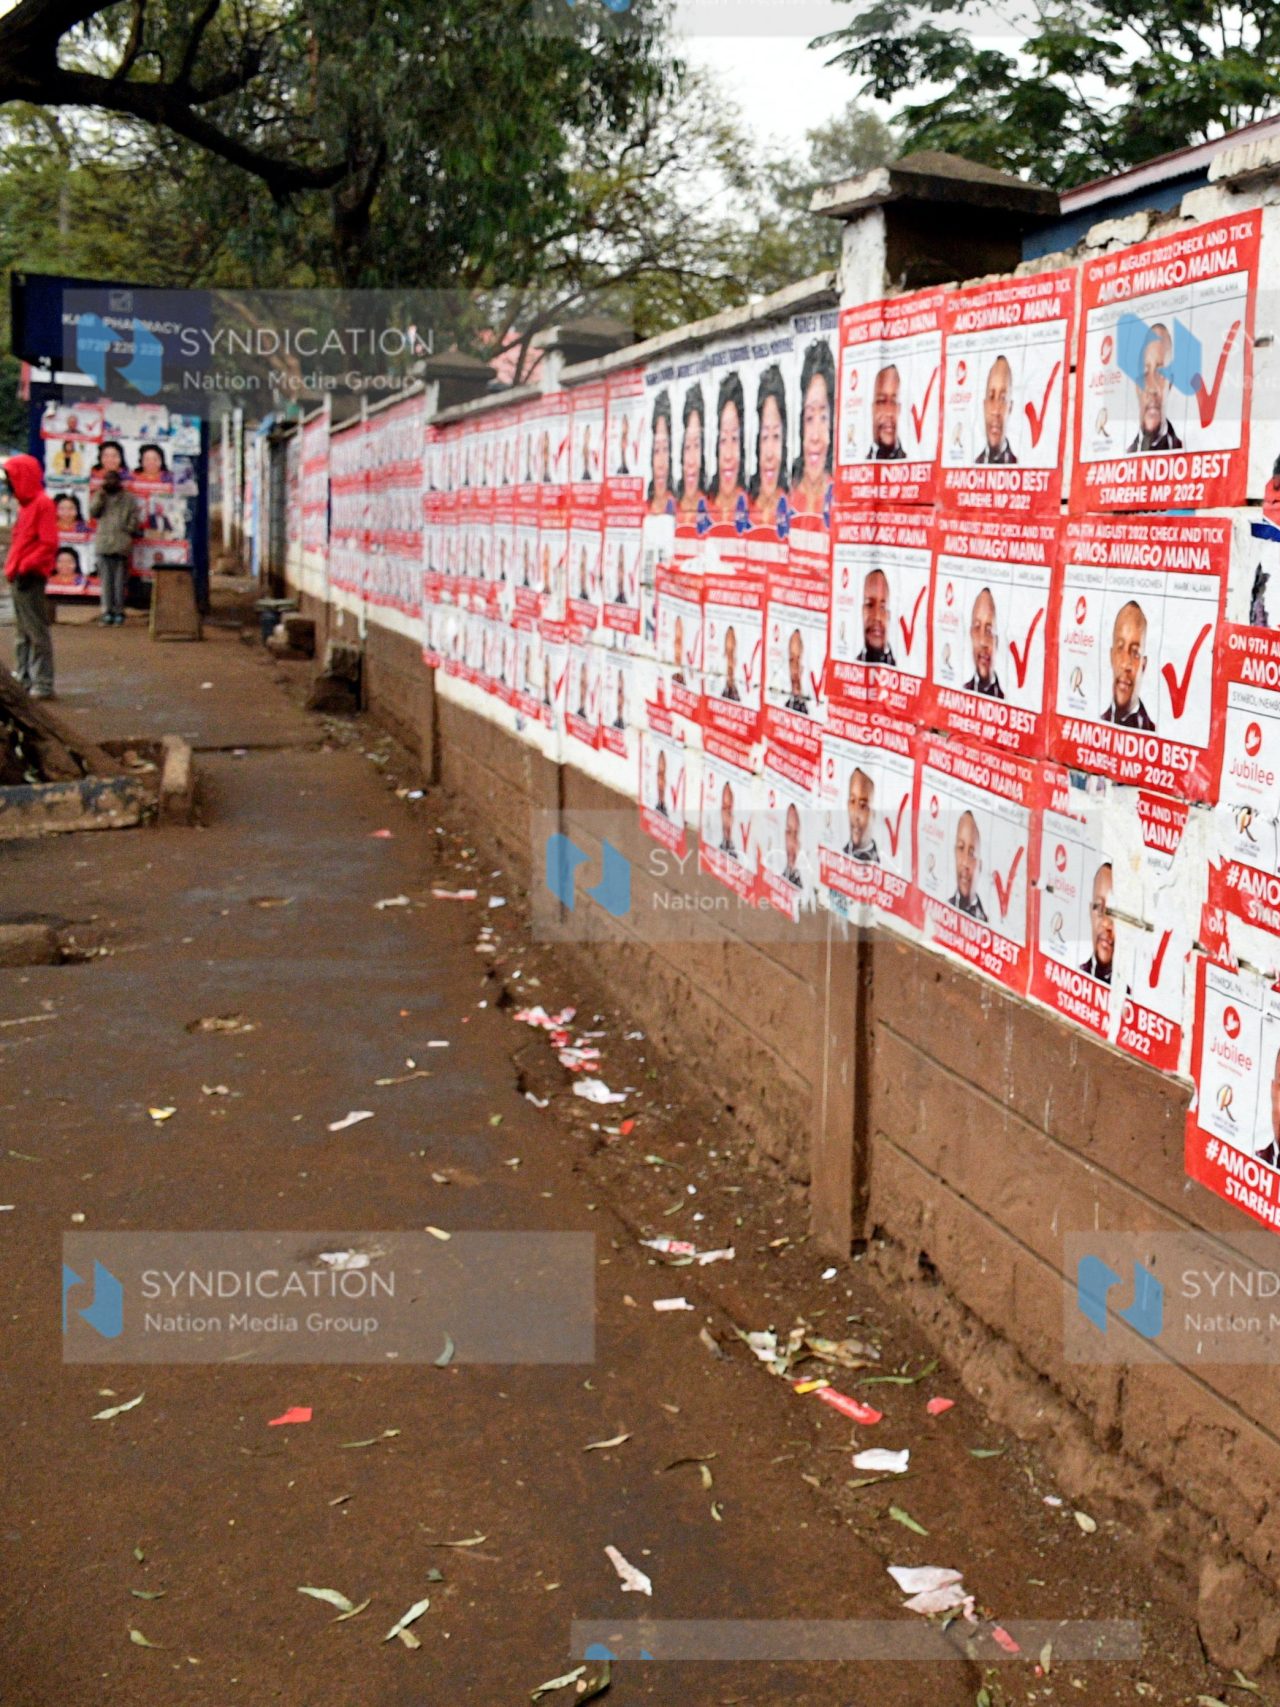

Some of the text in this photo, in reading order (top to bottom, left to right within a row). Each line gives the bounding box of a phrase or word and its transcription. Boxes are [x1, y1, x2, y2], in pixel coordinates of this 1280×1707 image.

[1230, 222, 1252, 240] TICK
[1133, 247, 1237, 293] MWAGO MAINA
[1022, 471, 1050, 492] BEST
[1086, 454, 1230, 486] #AMOH NDIO BEST
[1100, 483, 1204, 504] STAREHE MP 2022
[1180, 526, 1224, 544] AND TICK
[1010, 542, 1045, 562] MAINA
[1074, 542, 1211, 570] AMOS MWAGO MAINA
[1228, 634, 1247, 650] ON
[1248, 636, 1269, 657] 9TH
[978, 702, 1037, 735] NDIO BEST
[1062, 719, 1199, 772] #AMOH NDIO BEST
[1120, 758, 1175, 790] MP 2022
[1229, 758, 1275, 788] jubilee
[1045, 961, 1174, 1042] #AMOH BEST
[1057, 991, 1151, 1056] STAREHE 2022
[1204, 1138, 1274, 1195] #AMOH
